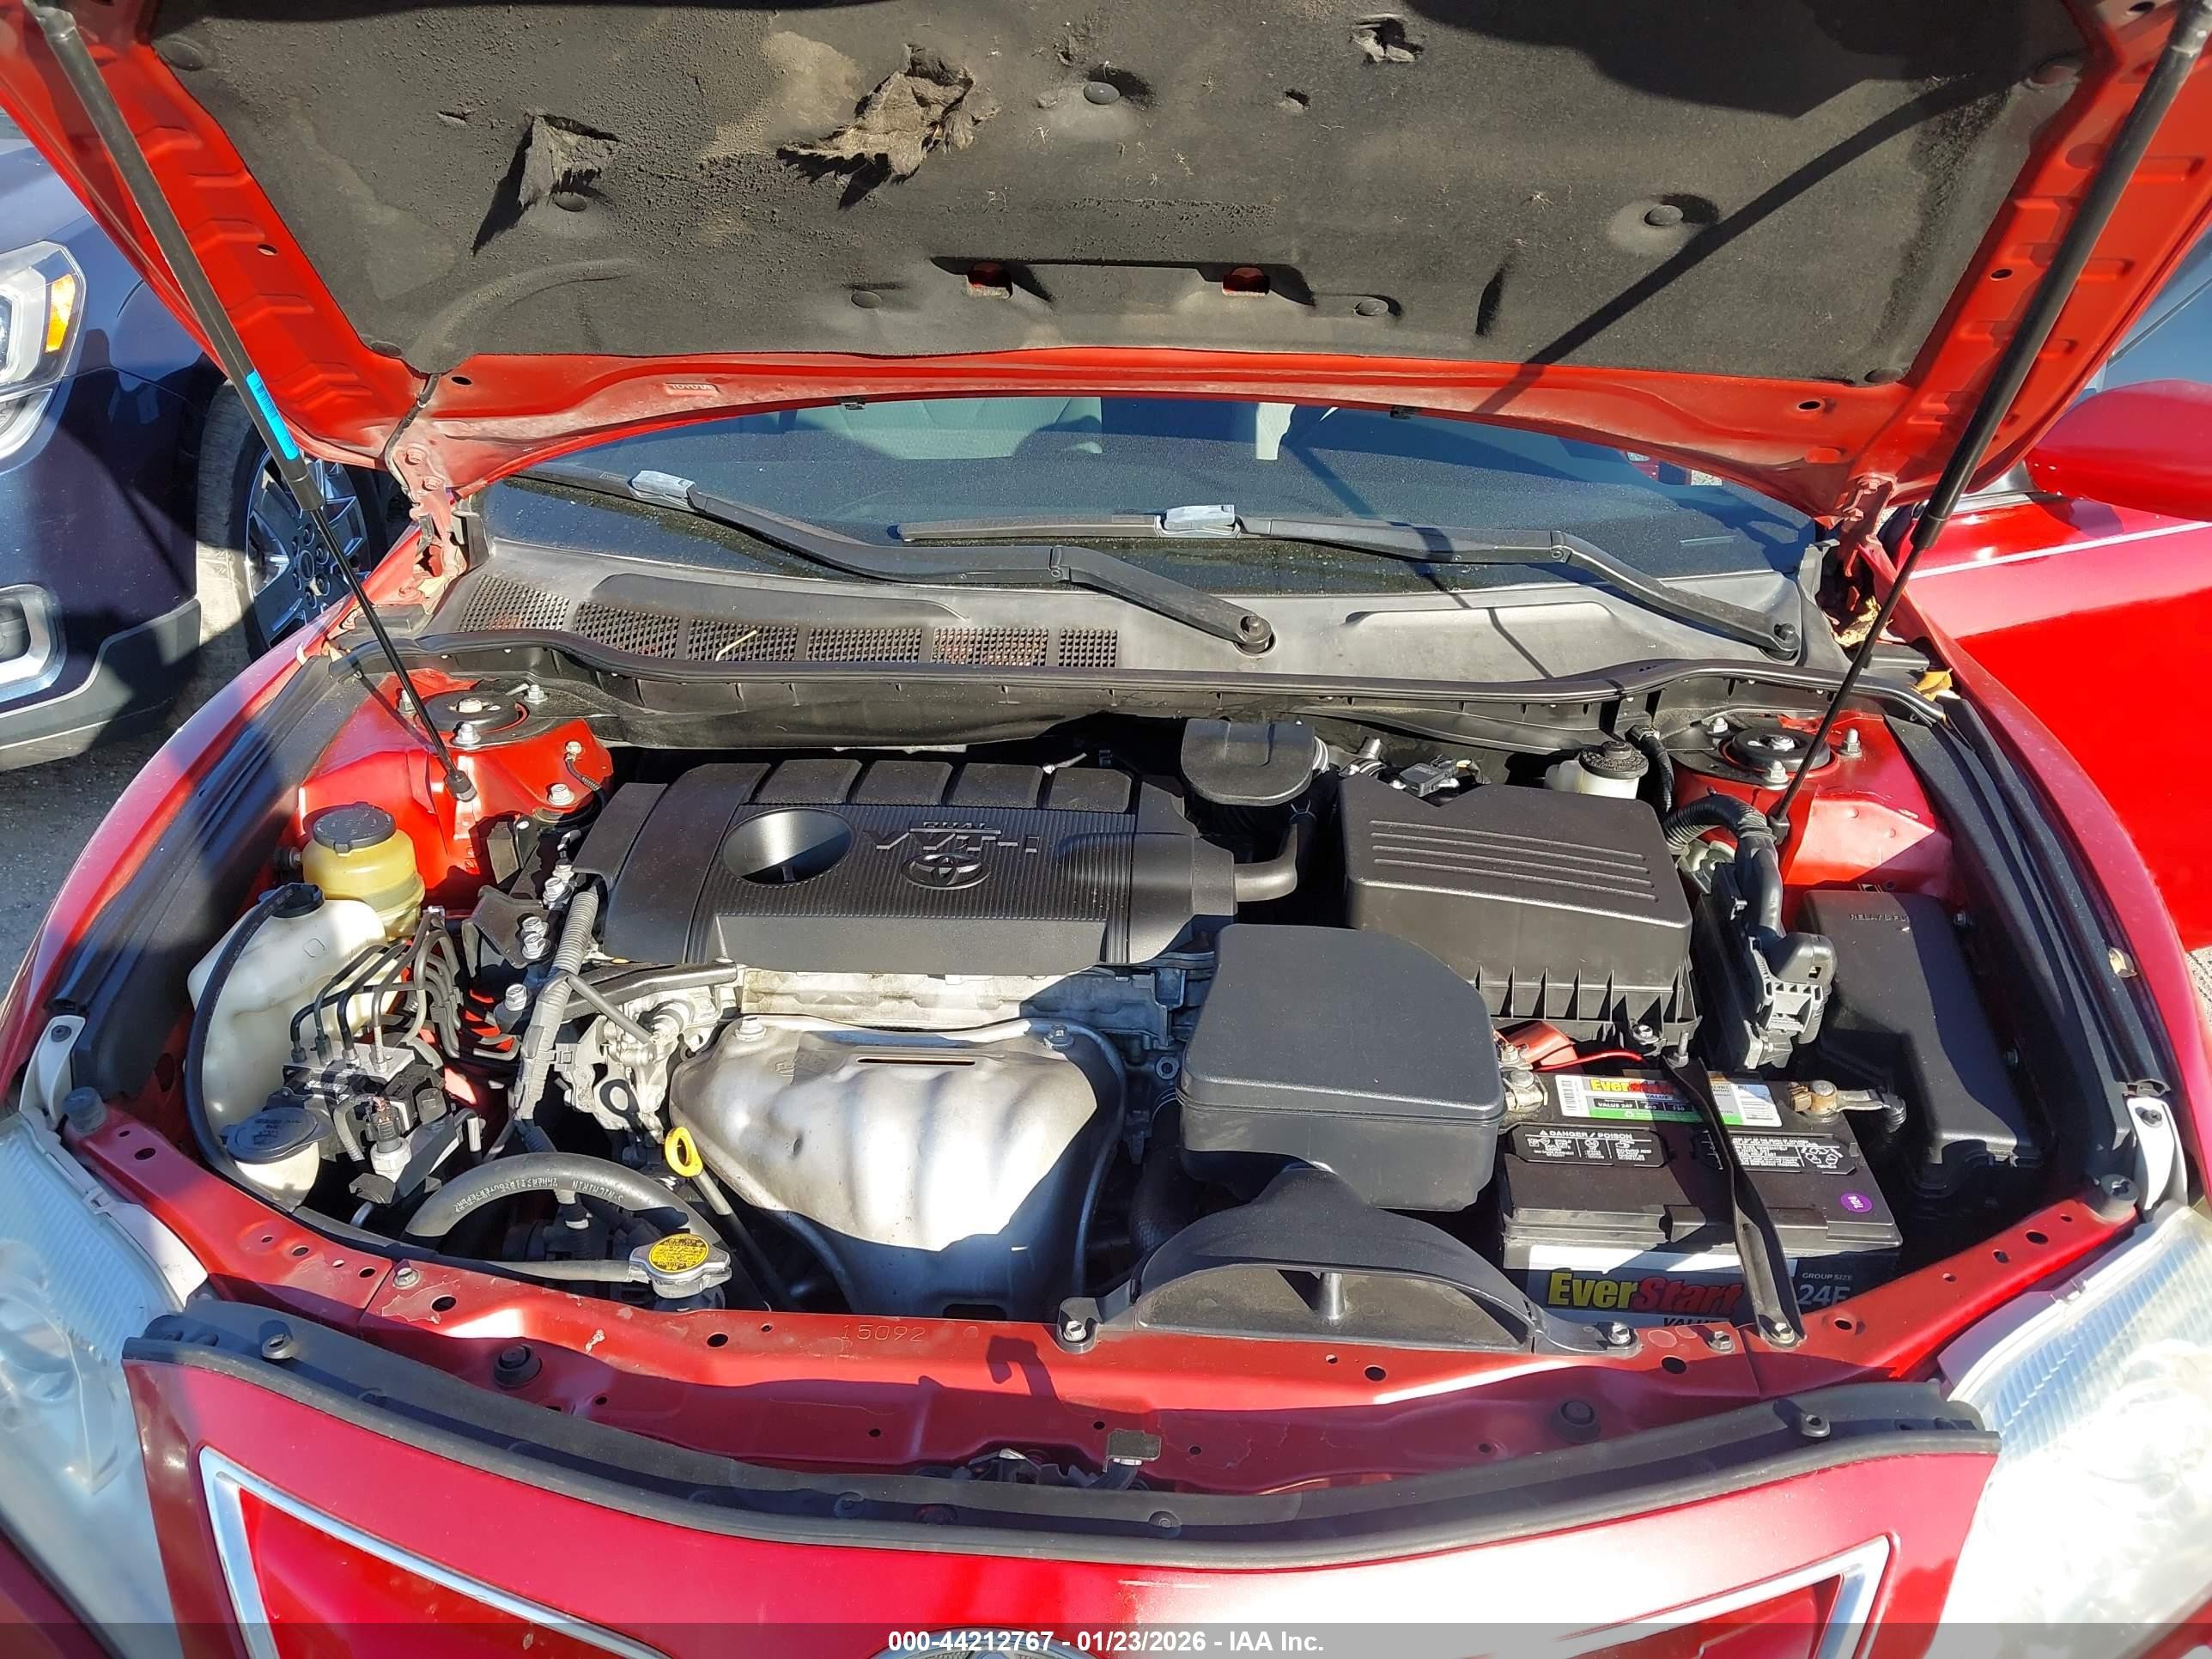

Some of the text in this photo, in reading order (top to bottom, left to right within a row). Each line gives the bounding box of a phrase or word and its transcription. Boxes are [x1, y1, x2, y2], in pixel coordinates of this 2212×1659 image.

[1549, 1130, 1589, 1139] DANGER
[1597, 1132, 1633, 1140] POISON
[1802, 1272, 1832, 1280] GROUP
[1547, 1272, 1745, 1315] EverStart
[1798, 1284, 1851, 1305] 24F
[841, 1323, 927, 1342] 15092
